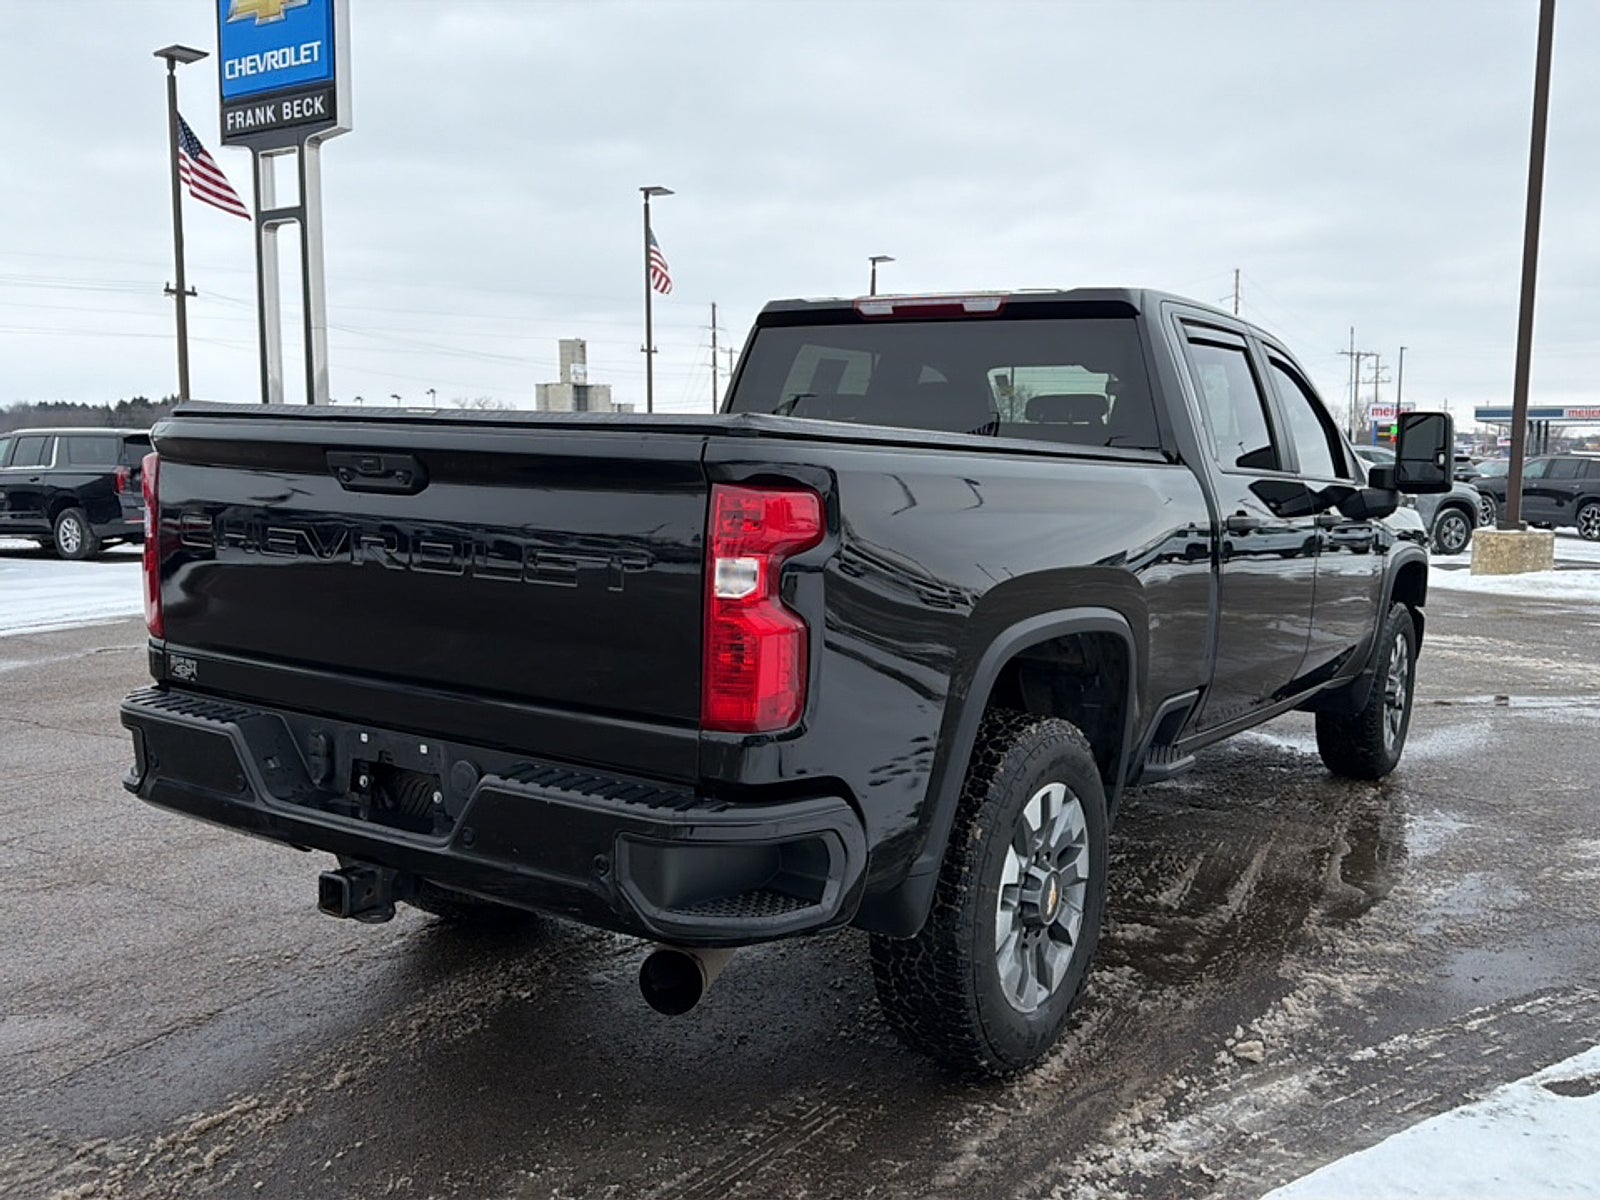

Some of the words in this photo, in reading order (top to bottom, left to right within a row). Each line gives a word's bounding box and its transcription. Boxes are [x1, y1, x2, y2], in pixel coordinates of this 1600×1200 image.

[224, 40, 322, 80] CHEVROLET
[226, 104, 277, 131] FRANK
[281, 95, 325, 120] BECK
[1371, 404, 1413, 420] meier
[180, 511, 656, 592] CHEVROLET
